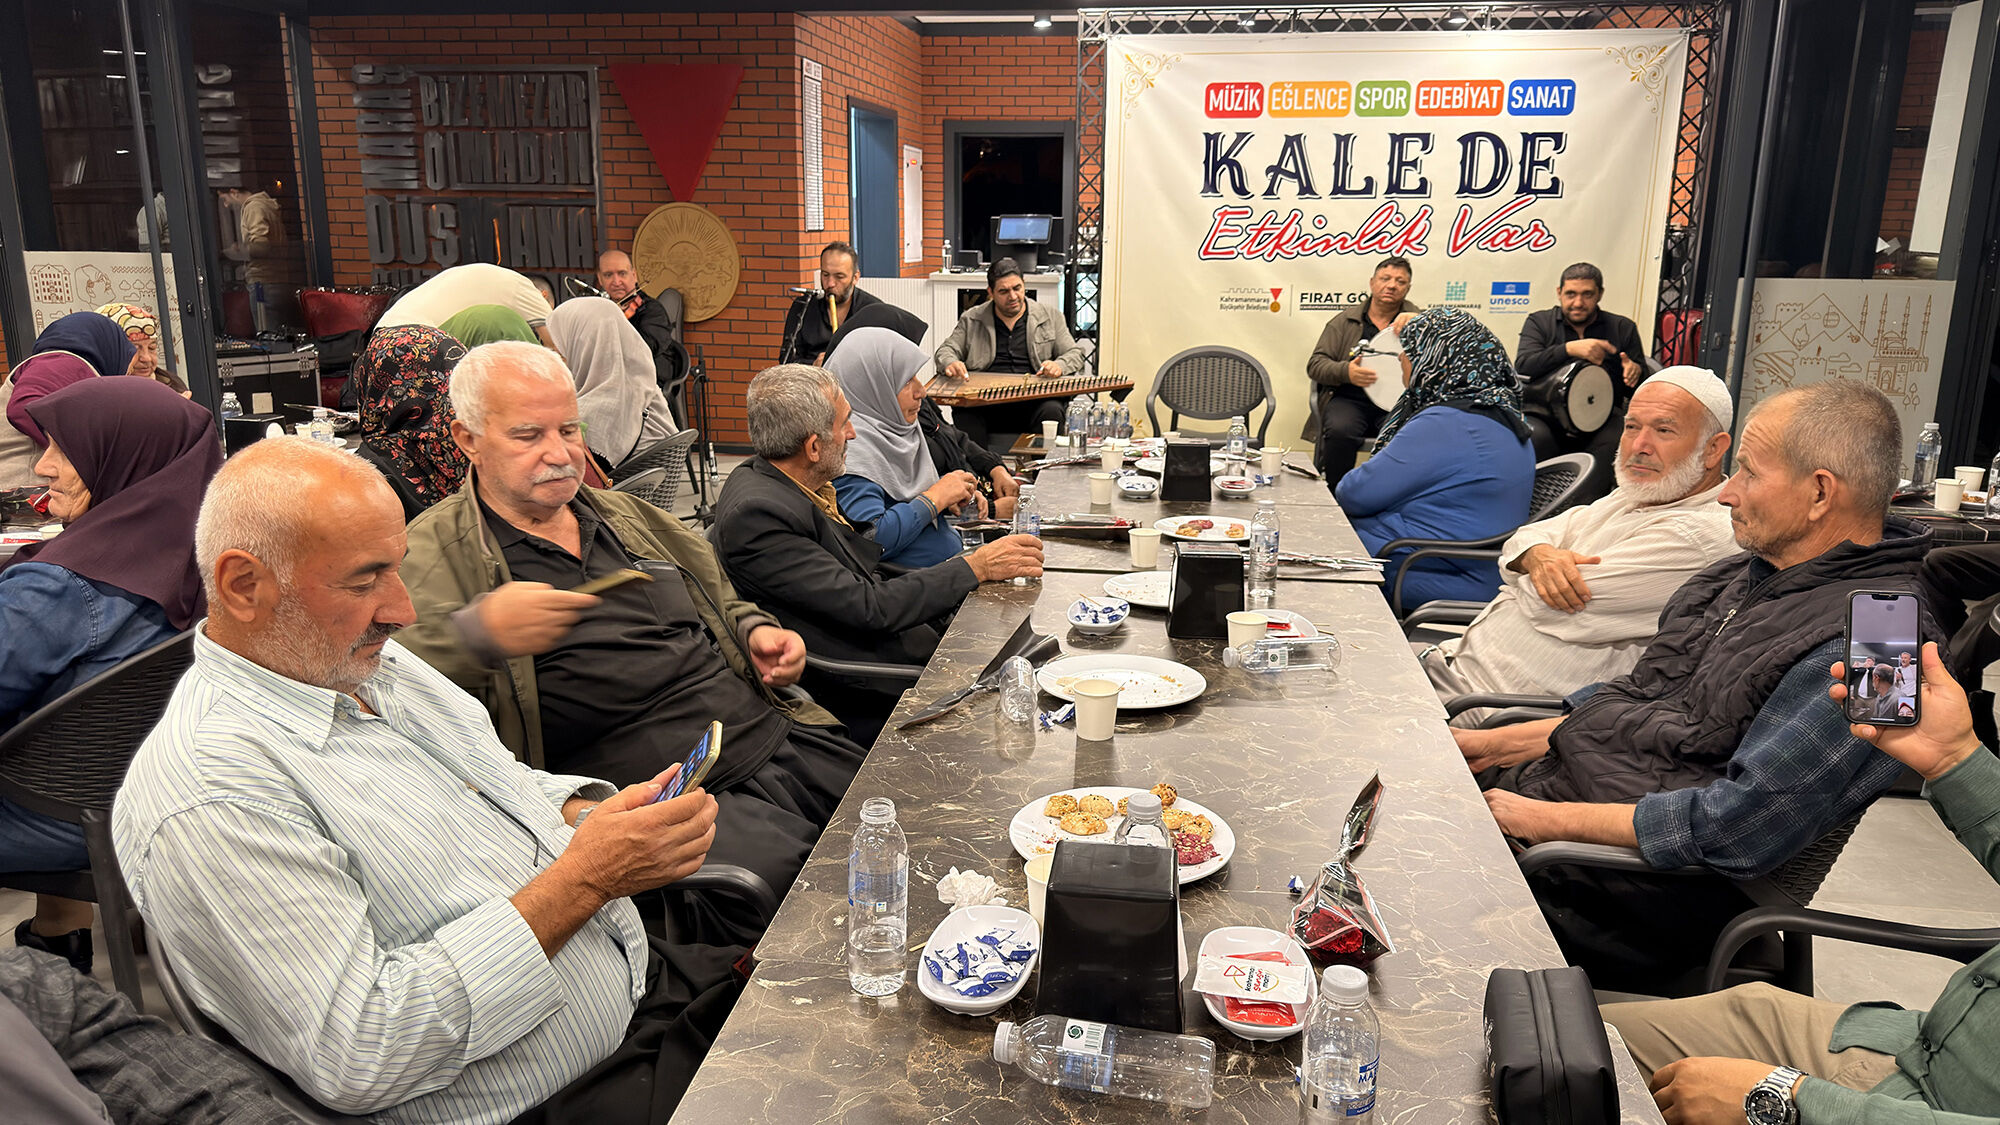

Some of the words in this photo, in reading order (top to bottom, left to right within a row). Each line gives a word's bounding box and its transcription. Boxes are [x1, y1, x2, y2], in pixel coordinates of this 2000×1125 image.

[1209, 84, 1261, 112] MÜZİK
[1272, 82, 1348, 111] EĞLENCE
[1358, 86, 1407, 110] SPOR
[1419, 81, 1501, 110] EDEBİYAT
[1511, 84, 1573, 109] SANAT
[1199, 131, 1435, 200] KALE
[1454, 131, 1568, 199] DE
[1199, 200, 1434, 261] Etkinlik
[1446, 194, 1556, 257] Var
[1300, 292, 1342, 304] FIRAT
[1489, 297, 1530, 306] unesco
